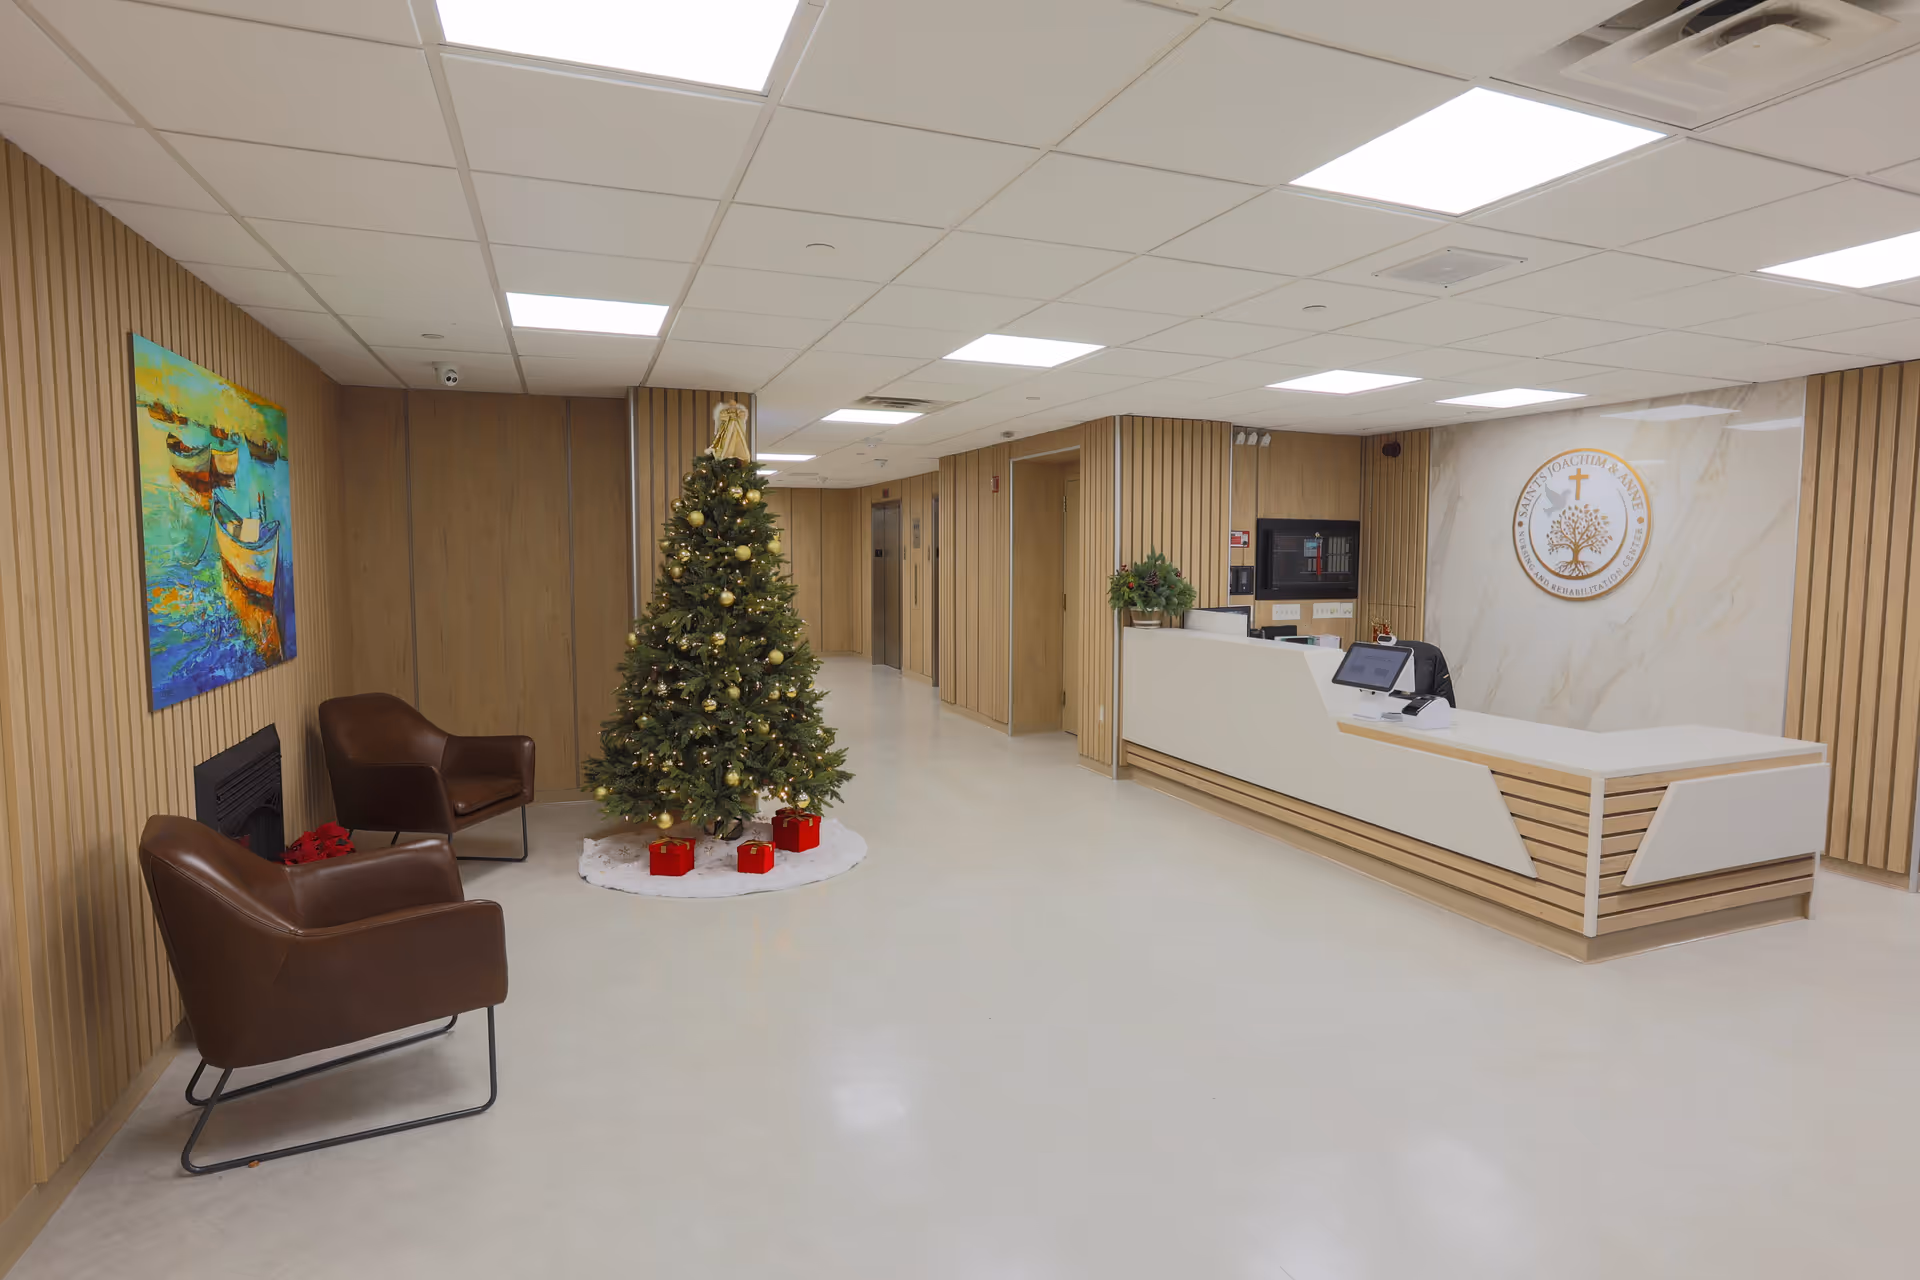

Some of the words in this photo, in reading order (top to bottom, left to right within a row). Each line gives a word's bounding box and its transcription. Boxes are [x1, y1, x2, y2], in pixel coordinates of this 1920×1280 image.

[1520, 471, 1547, 517] SAINTS
[1547, 454, 1607, 477] JOACHIM
[1608, 463, 1619, 475] &
[1619, 473, 1643, 511] ANNE
[1518, 531, 1535, 571] NURSING
[1534, 571, 1549, 587] AND
[1551, 568, 1624, 596] REHABILITATION
